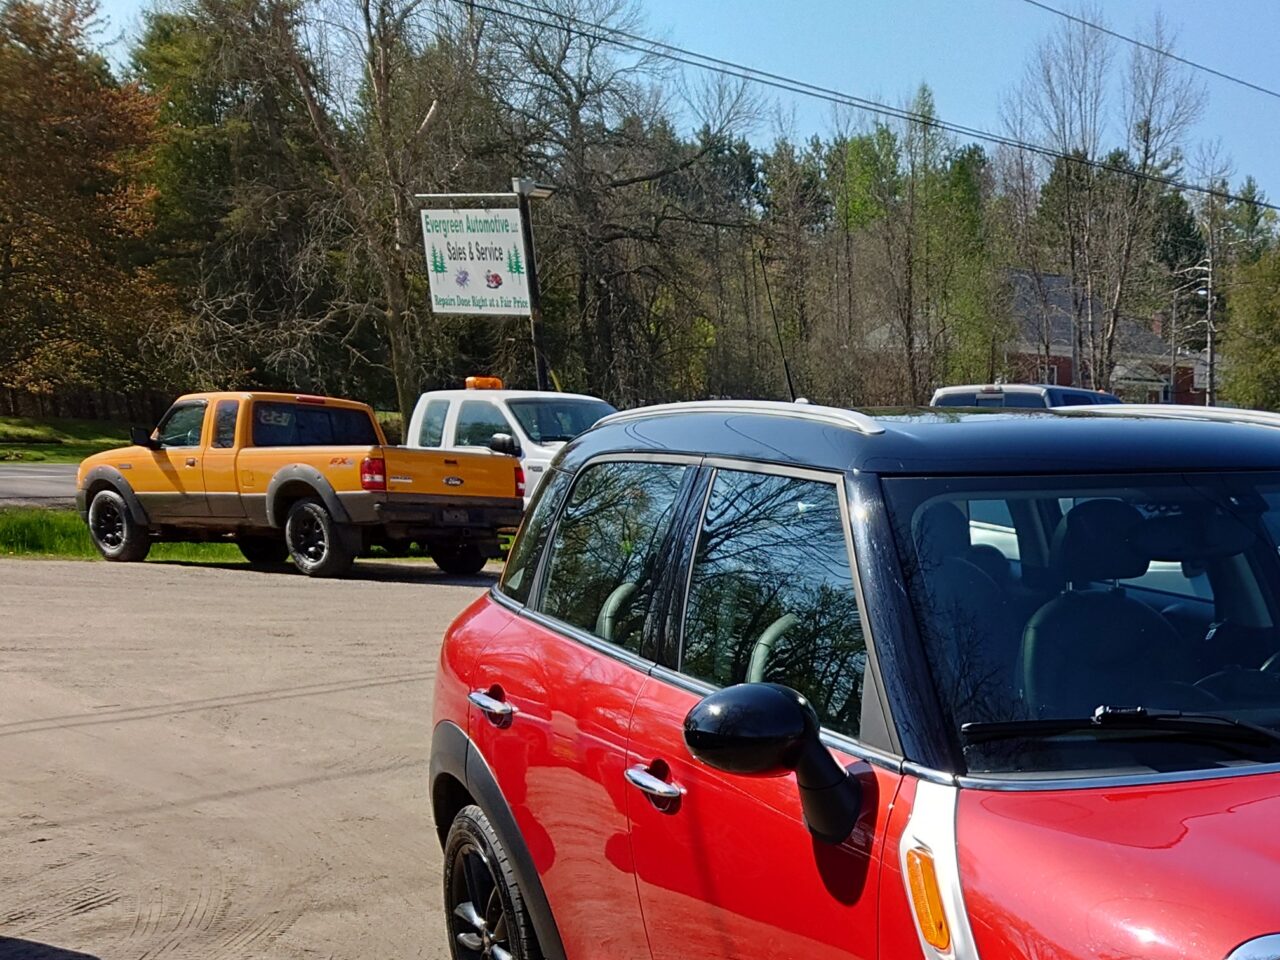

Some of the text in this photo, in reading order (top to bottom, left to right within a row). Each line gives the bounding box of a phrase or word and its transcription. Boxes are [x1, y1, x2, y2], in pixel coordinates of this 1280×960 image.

[425, 214, 464, 238] Evergreen
[466, 214, 509, 233] Automotive
[446, 241, 503, 261] Sales & Service
[434, 294, 456, 308] Repairs
[456, 294, 471, 306] Done
[471, 295, 488, 310] Right
[500, 296, 512, 308] Fair
[512, 296, 528, 309] Price
